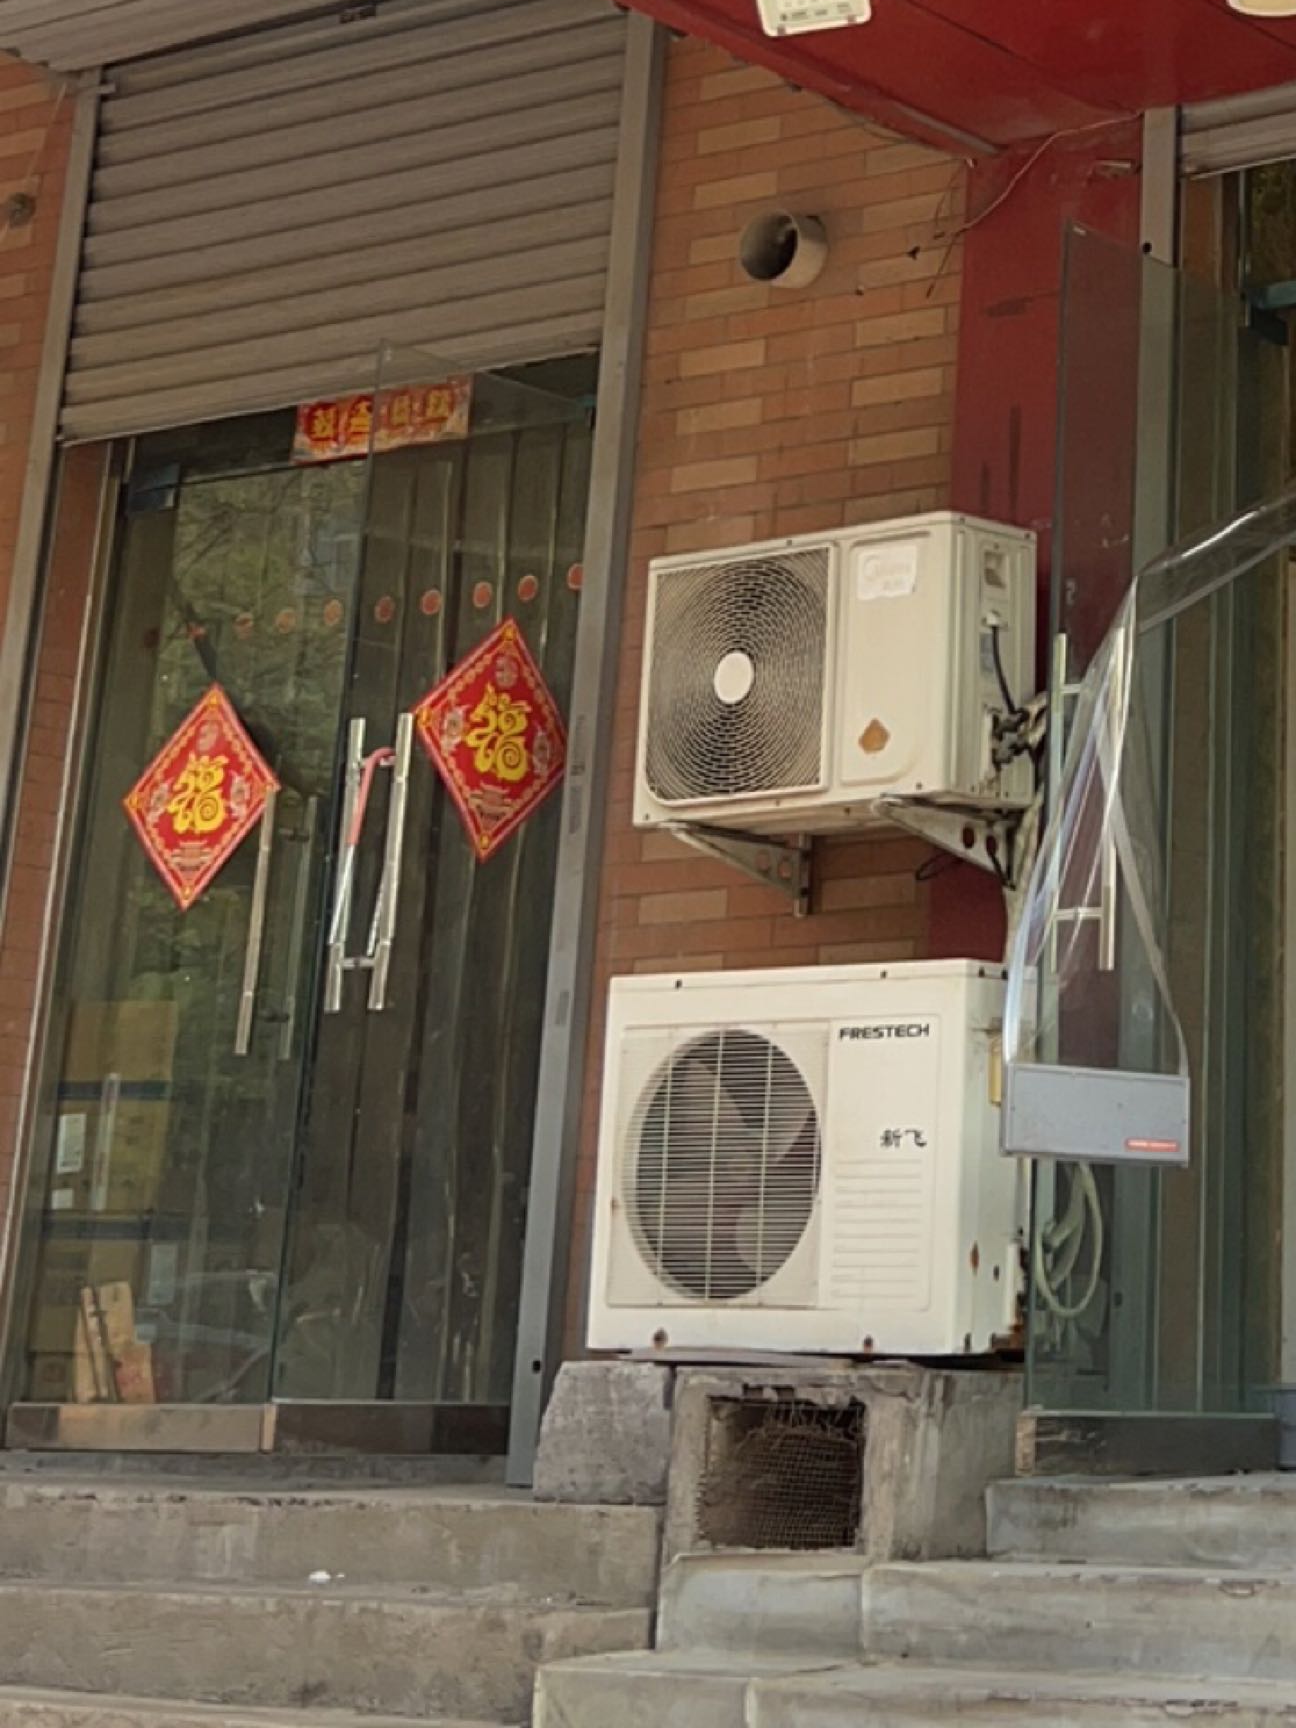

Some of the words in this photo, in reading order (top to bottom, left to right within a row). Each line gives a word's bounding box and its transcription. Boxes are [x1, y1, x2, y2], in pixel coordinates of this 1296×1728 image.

[466, 682, 532, 781] 福
[167, 751, 229, 835] 福
[839, 1023, 930, 1041] FRESTECH
[881, 1128, 928, 1148] 新飞
